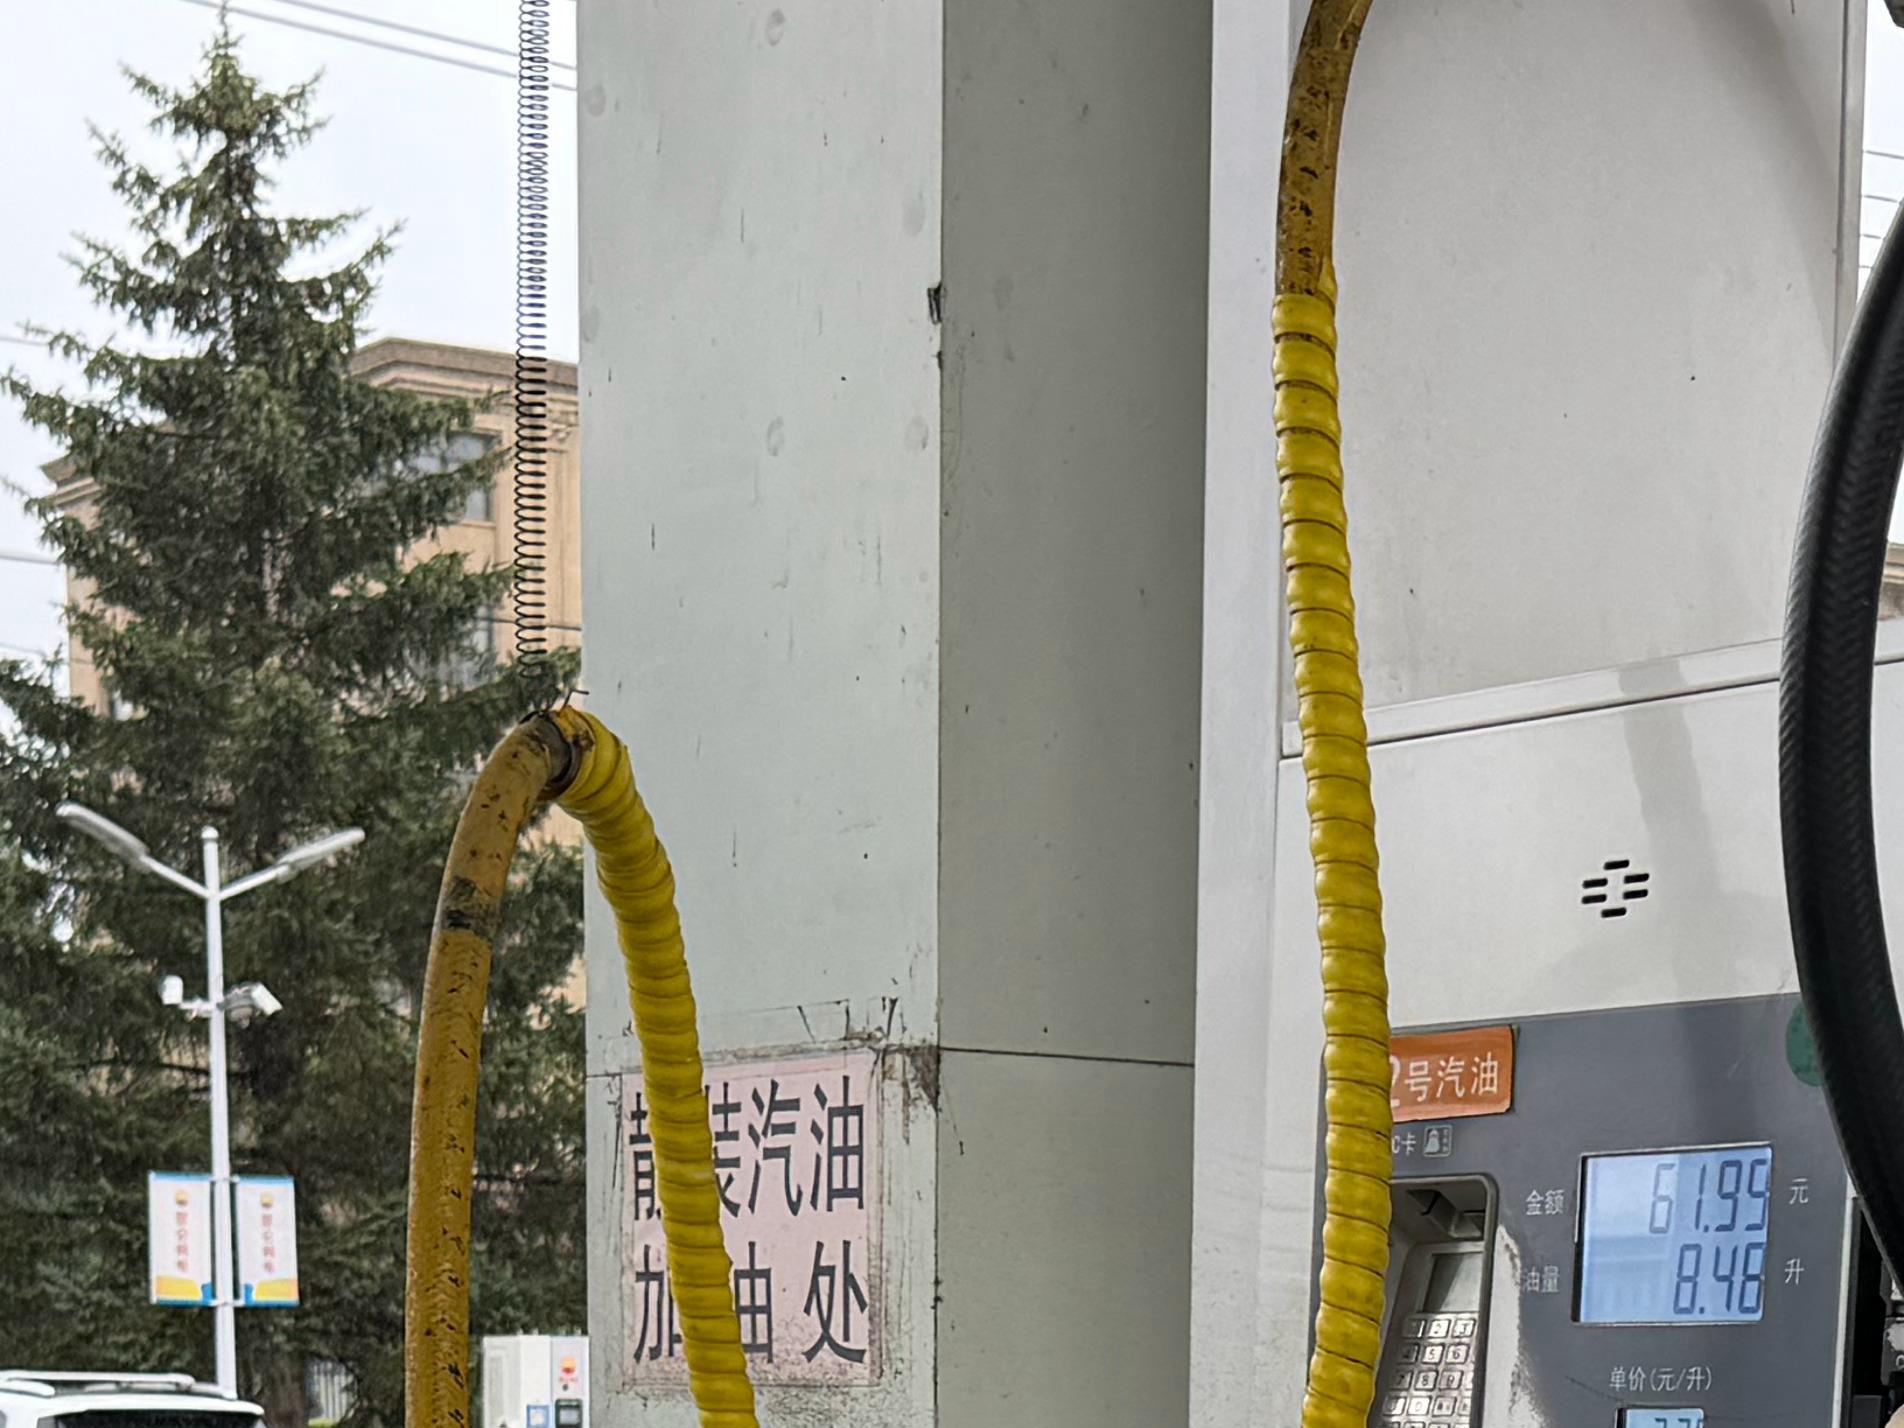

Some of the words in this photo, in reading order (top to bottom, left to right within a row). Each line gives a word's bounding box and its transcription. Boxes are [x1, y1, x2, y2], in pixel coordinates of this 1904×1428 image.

[1390, 1052, 1498, 1107] 2号汽油
[1392, 1131, 1416, 1155] C卡
[1526, 1189, 1565, 1215] 金额
[1789, 1178, 1808, 1204] 元
[1524, 1266, 1560, 1292] 油量
[1785, 1259, 1804, 1284] 升
